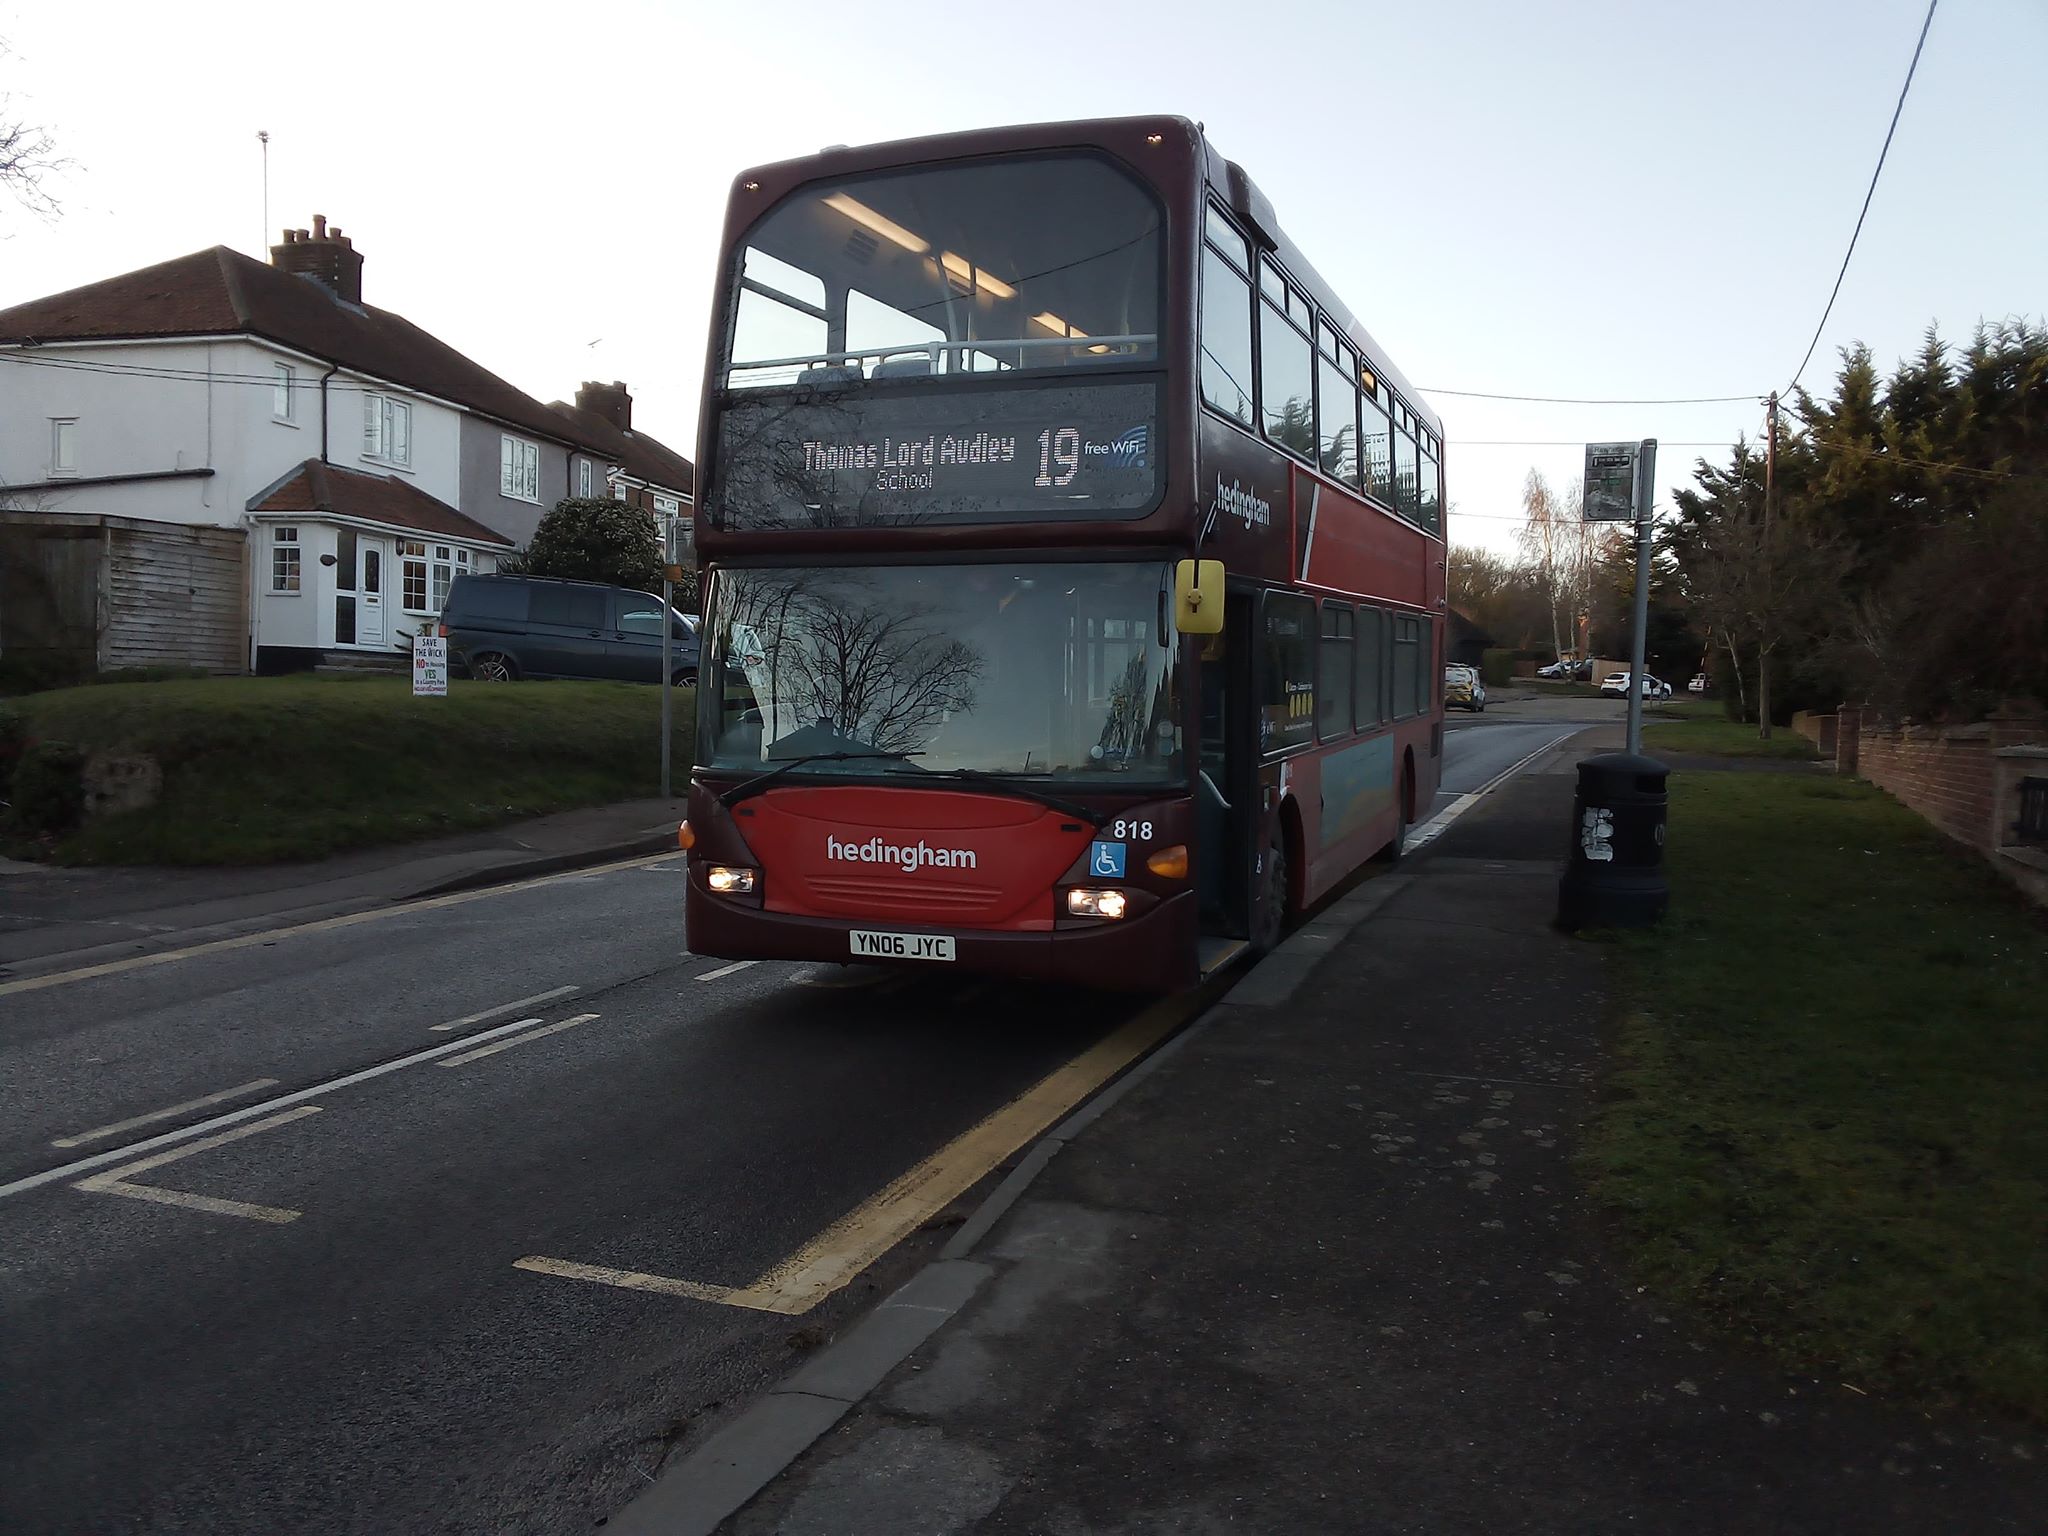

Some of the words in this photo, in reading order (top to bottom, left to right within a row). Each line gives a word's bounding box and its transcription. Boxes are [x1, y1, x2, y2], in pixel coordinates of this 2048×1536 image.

[803, 442, 877, 471] Thomas
[884, 435, 934, 467] Lord
[940, 433, 1016, 465] Audley
[1034, 427, 1080, 487] 19
[1084, 440, 1109, 455] free
[1111, 440, 1140, 454] WiFi
[876, 467, 933, 490] School
[1217, 470, 1270, 530] hedingham
[415, 648, 426, 657] THE
[422, 638, 437, 647] SAVE
[416, 658, 425, 669] NO
[424, 669, 437, 679] YES
[1114, 820, 1153, 841] 818
[827, 834, 976, 872] hedingham
[856, 934, 904, 956] YN06
[911, 937, 948, 959] JYC
